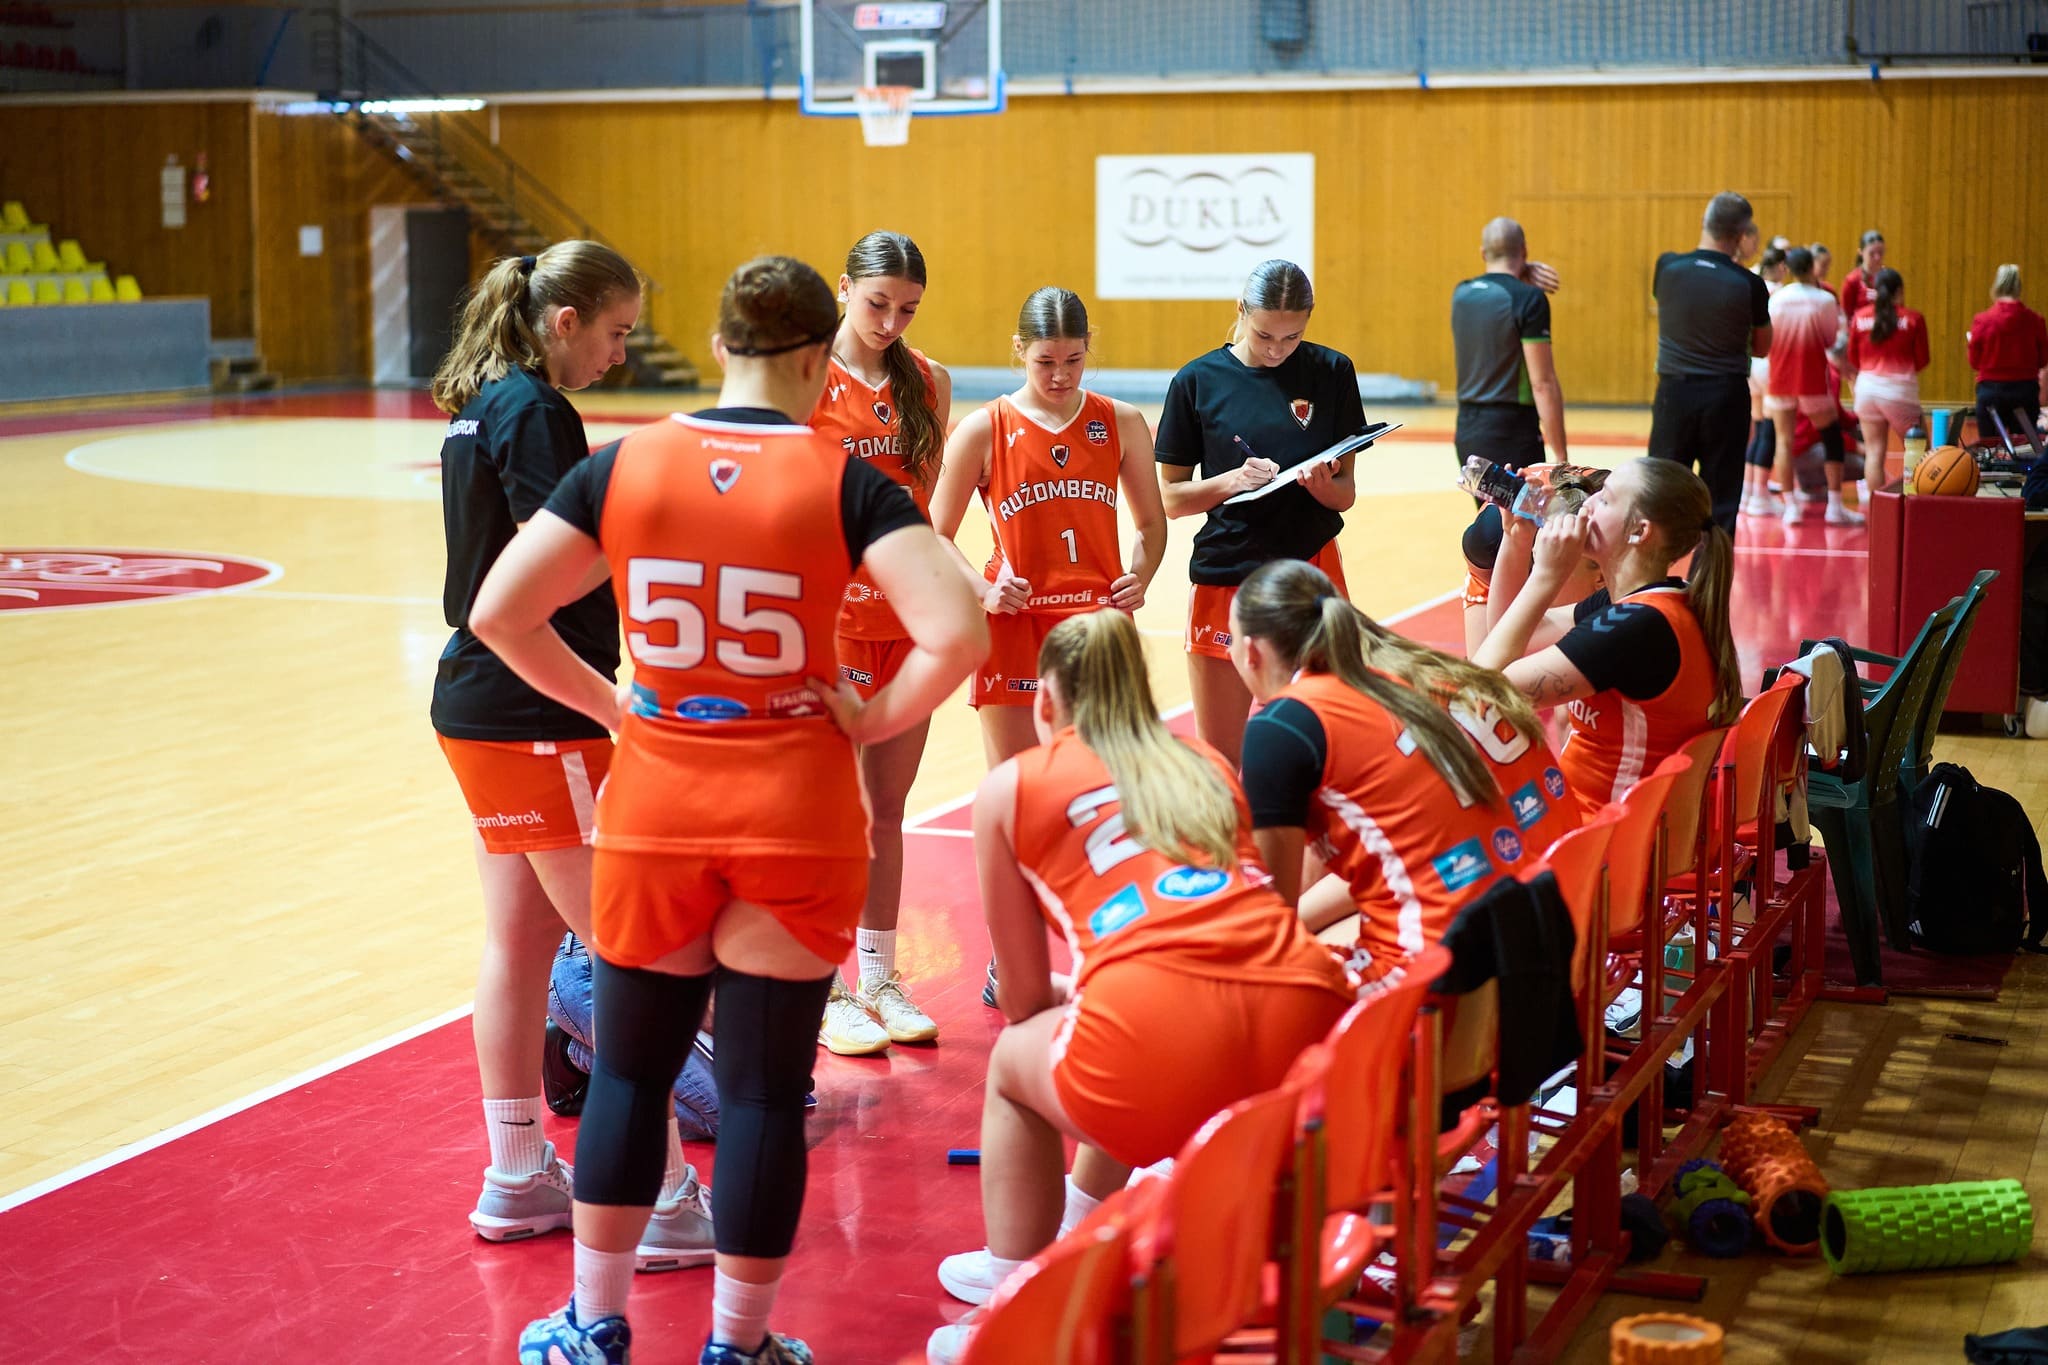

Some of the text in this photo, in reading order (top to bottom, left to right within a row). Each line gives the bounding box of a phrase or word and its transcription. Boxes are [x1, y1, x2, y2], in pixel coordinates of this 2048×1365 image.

[1128, 194, 1281, 230] DUKLA
[998, 479, 1118, 522] RUŽOMBERO
[1060, 528, 1079, 564] 1
[1029, 590, 1093, 606] mondi
[627, 556, 807, 677] 55
